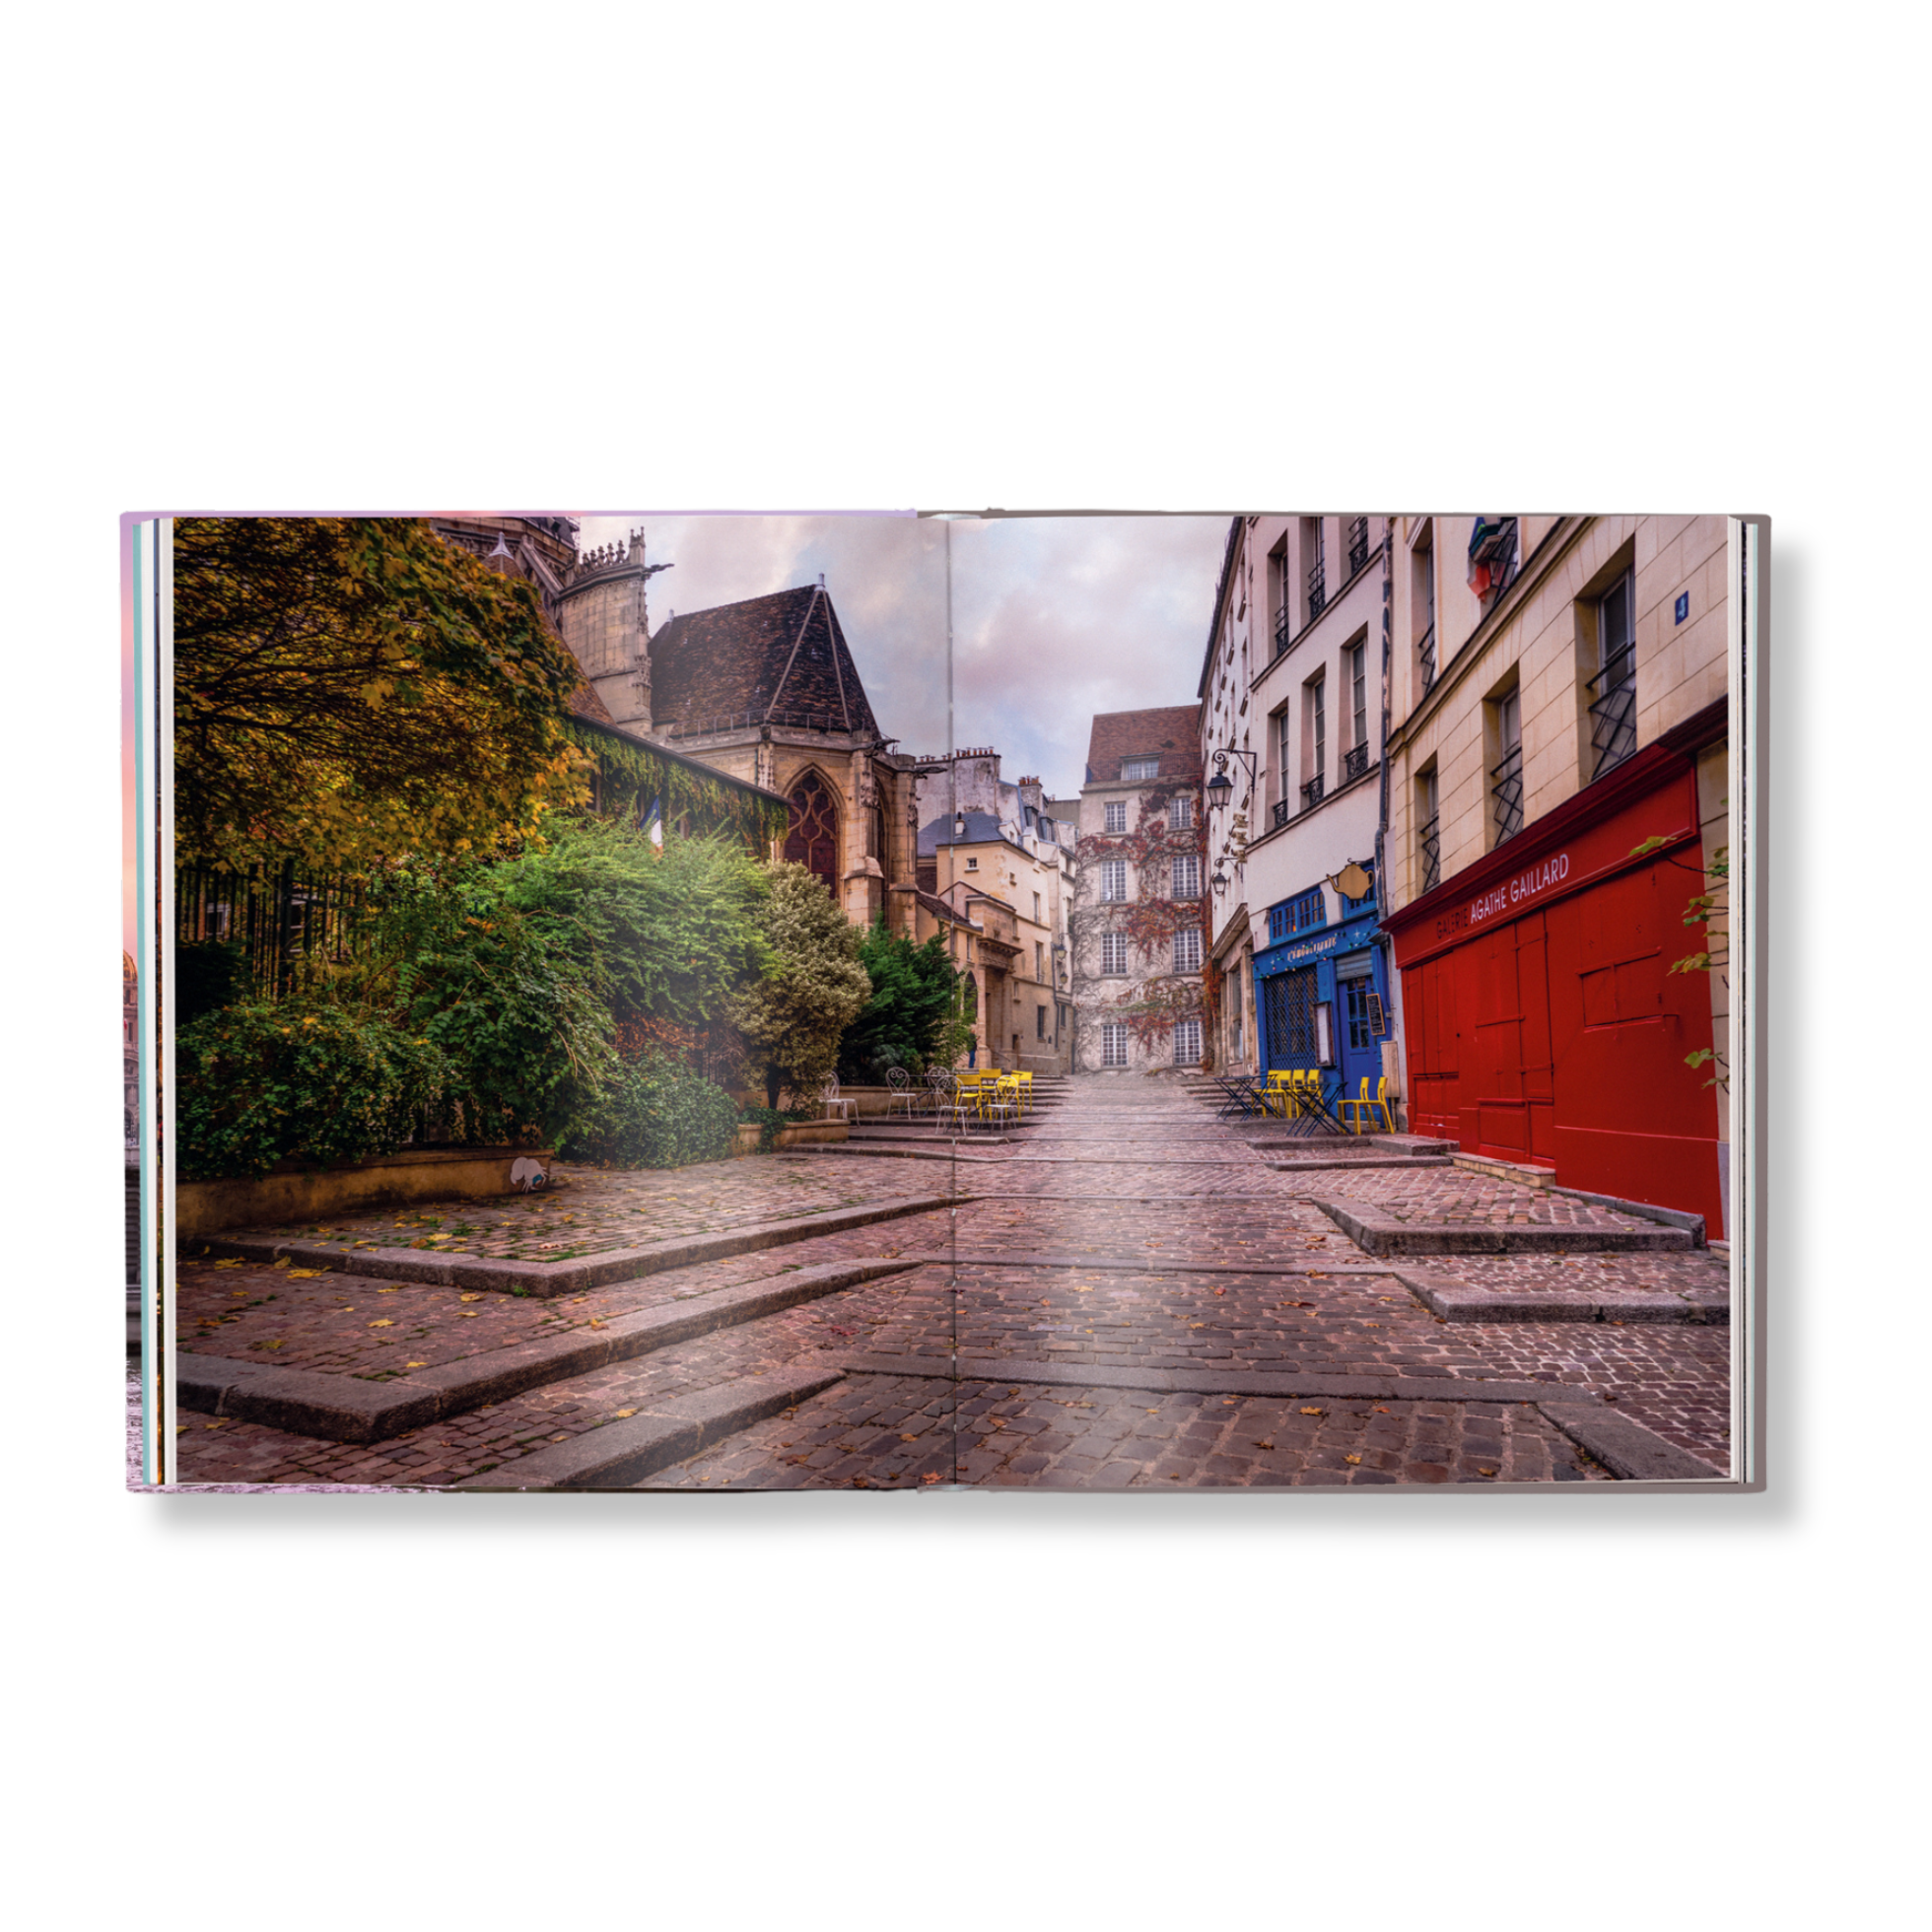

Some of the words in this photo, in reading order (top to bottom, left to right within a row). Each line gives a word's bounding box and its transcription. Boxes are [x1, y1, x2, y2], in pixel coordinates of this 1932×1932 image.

[1437, 908, 1468, 939] GALERIE
[1470, 886, 1507, 924] AGATHE
[1510, 853, 1569, 903] GAILLARD
